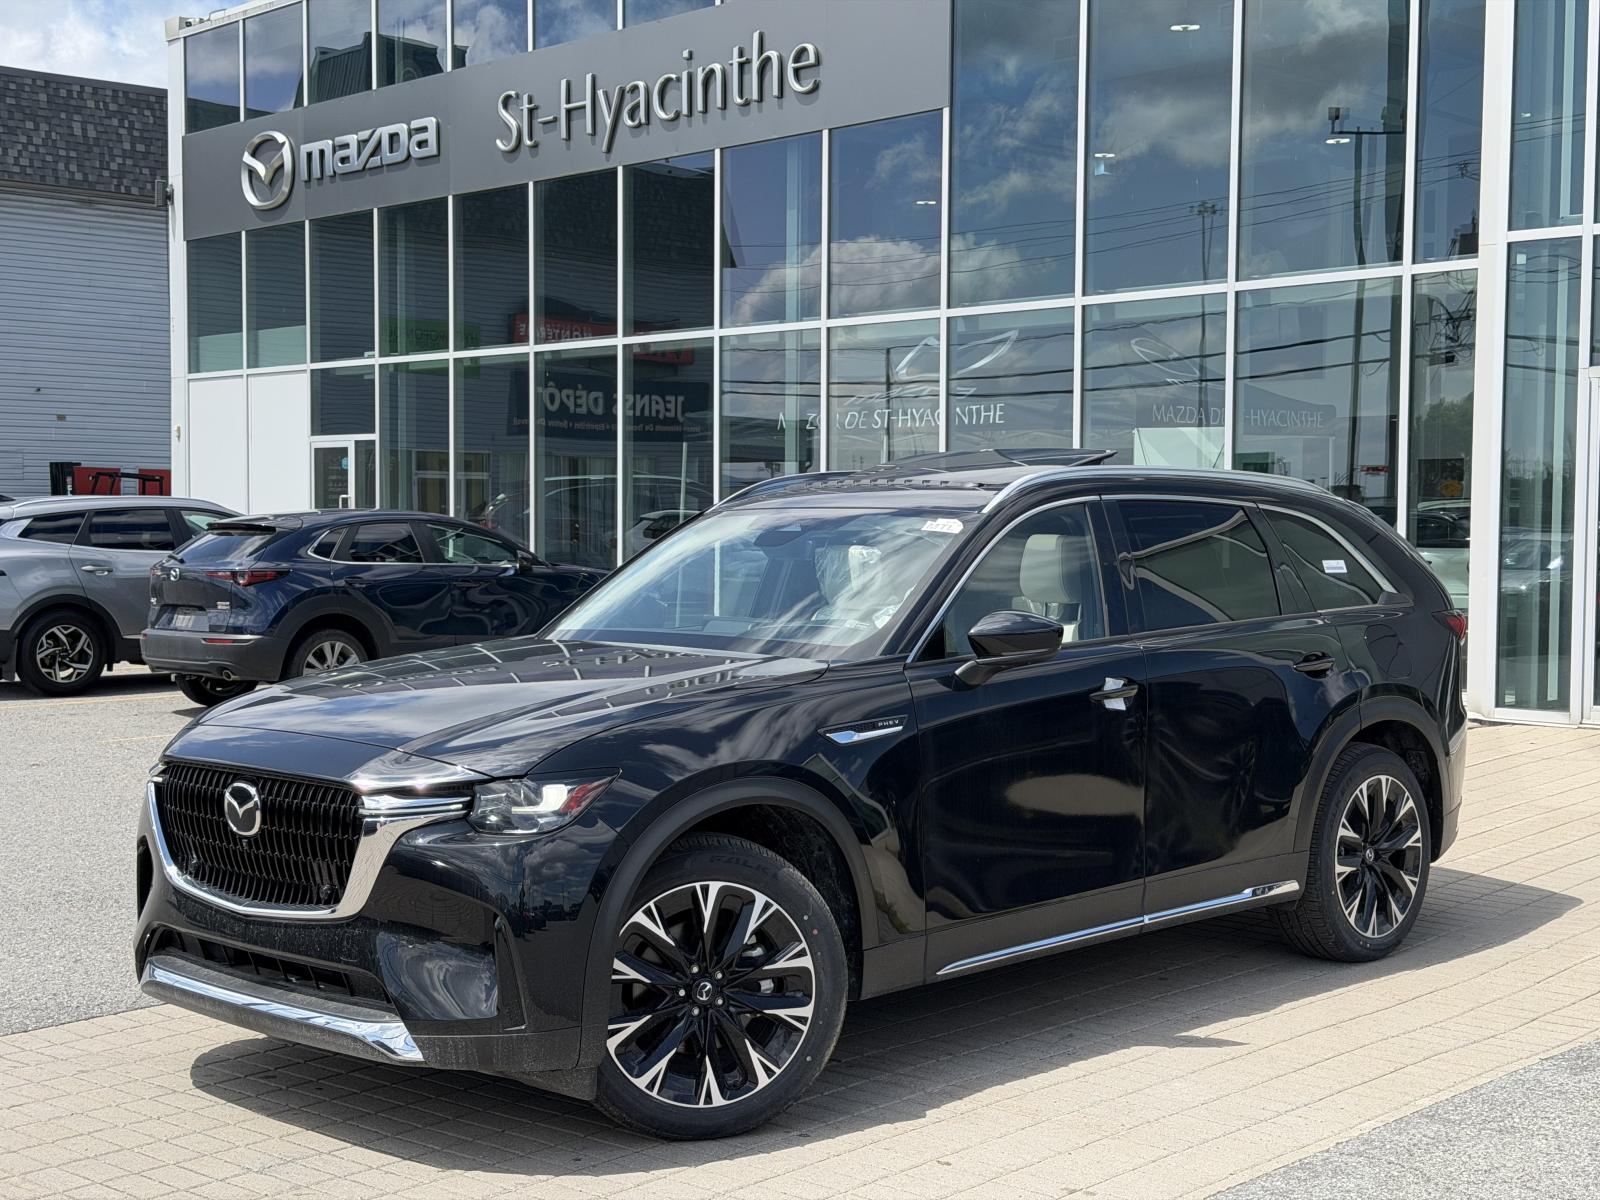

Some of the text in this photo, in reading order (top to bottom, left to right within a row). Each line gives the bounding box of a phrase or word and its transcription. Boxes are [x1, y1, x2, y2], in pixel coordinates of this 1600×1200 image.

[496, 30, 821, 153] St-Hyacinthe
[844, 410, 868, 429] DE
[872, 403, 1005, 429] ST-HYACNTHE
[1152, 404, 1206, 425] MAZDA
[1245, 408, 1324, 428] -HYACINTHE
[878, 718, 899, 728] PHEV
